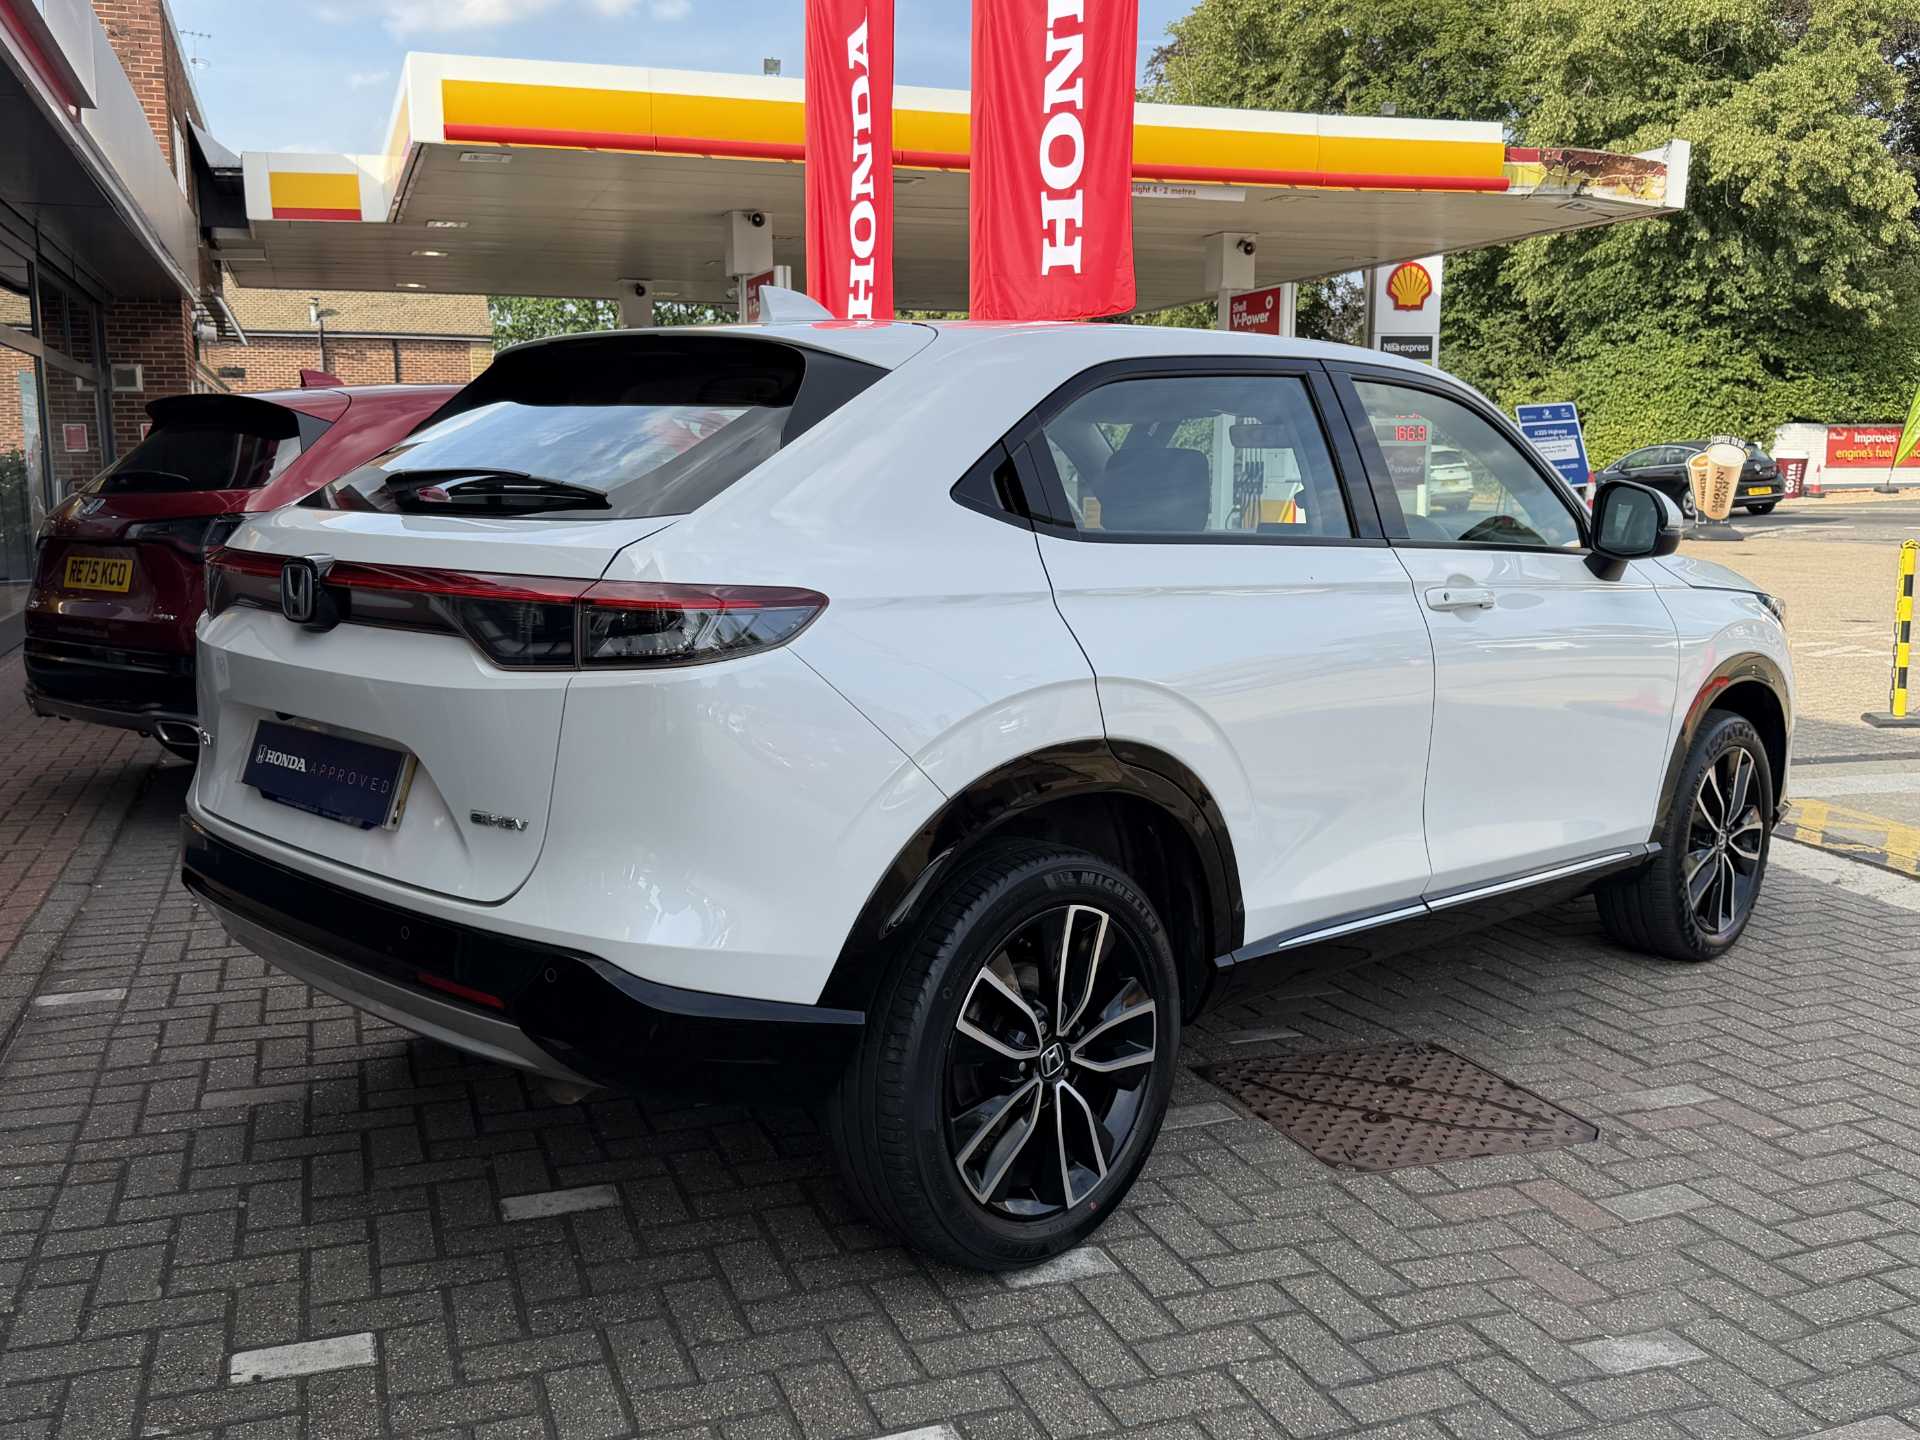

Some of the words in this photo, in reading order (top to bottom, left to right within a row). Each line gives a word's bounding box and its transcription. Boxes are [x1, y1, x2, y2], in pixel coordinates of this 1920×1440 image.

[847, 6, 877, 323] HONDA
[1171, 188, 1197, 196] metres
[1232, 311, 1270, 329] V-Power
[1854, 431, 1897, 446] Improves
[1875, 446, 1893, 458] fuel
[1784, 463, 1797, 494] COSTA
[70, 559, 99, 584] RE75
[265, 749, 307, 773] HONDA
[310, 761, 390, 794] APPROVED
